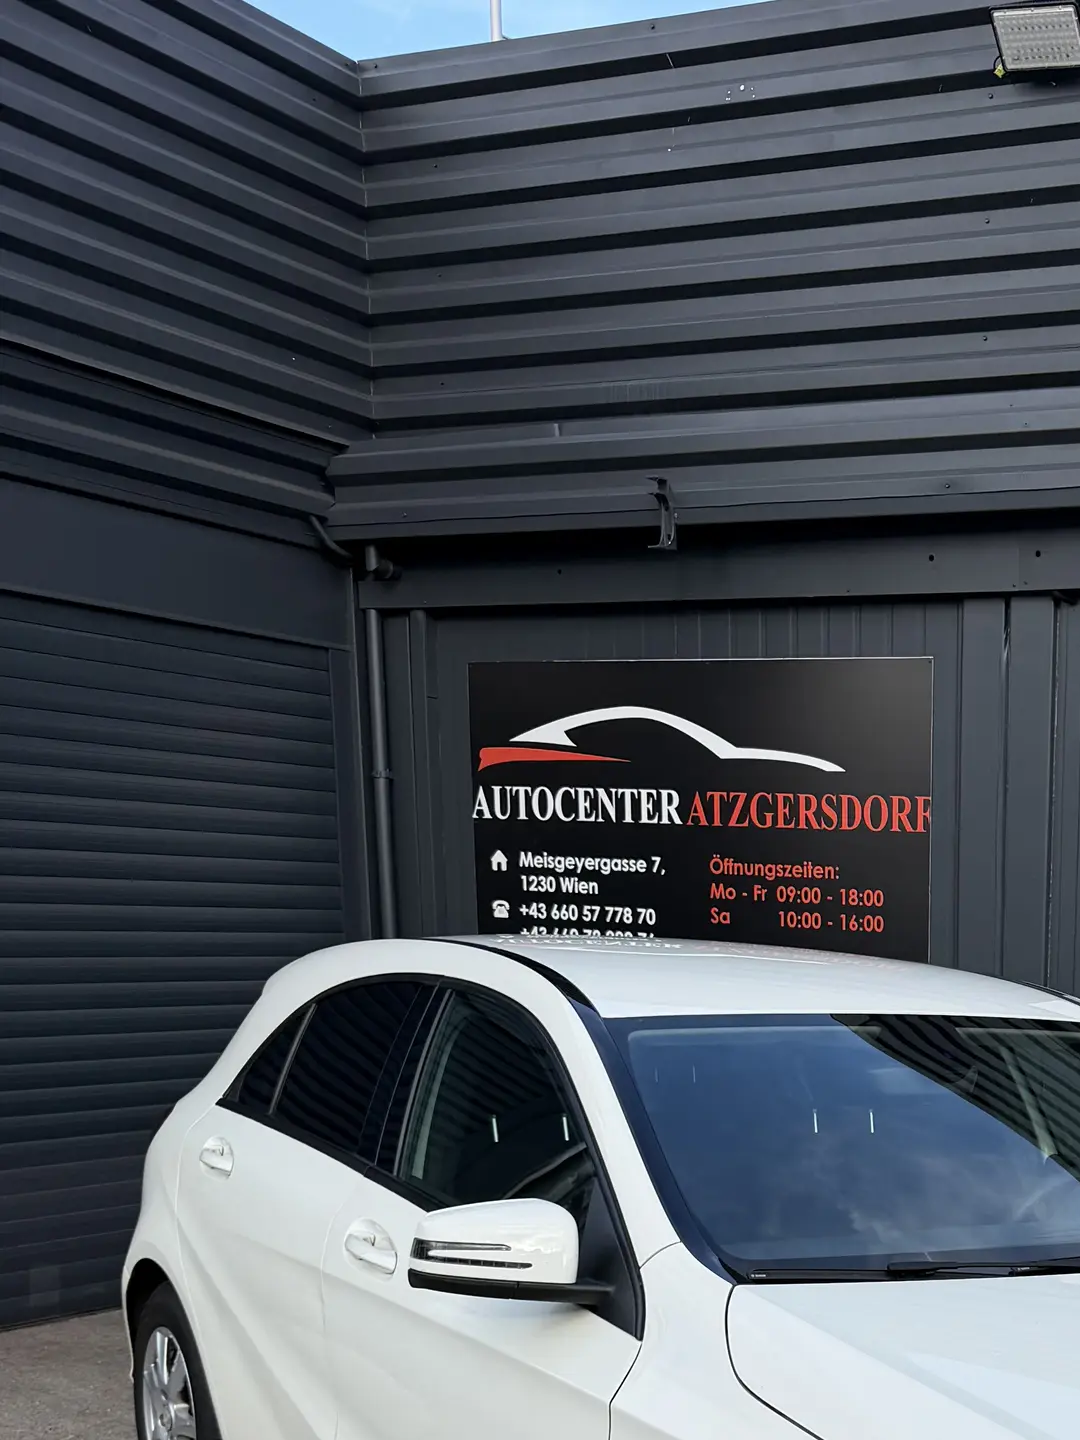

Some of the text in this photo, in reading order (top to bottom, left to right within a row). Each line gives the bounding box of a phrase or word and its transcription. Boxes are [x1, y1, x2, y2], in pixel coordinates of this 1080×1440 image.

[472, 786, 931, 833] AUTOCENTER ATZGERSDORF
[518, 851, 666, 876] Meisgeyergasse 7,
[709, 854, 840, 881] Öffnungszeiten:
[520, 874, 599, 895] 1230 Wien
[709, 882, 736, 900] Mo
[753, 884, 768, 901] Fr
[776, 885, 822, 904] 09:00
[839, 888, 884, 907] 18:00
[519, 902, 657, 926] +43 660 57 778 70
[710, 907, 731, 924] Sa
[778, 911, 822, 930] 10:00
[839, 913, 884, 932] 16:00
